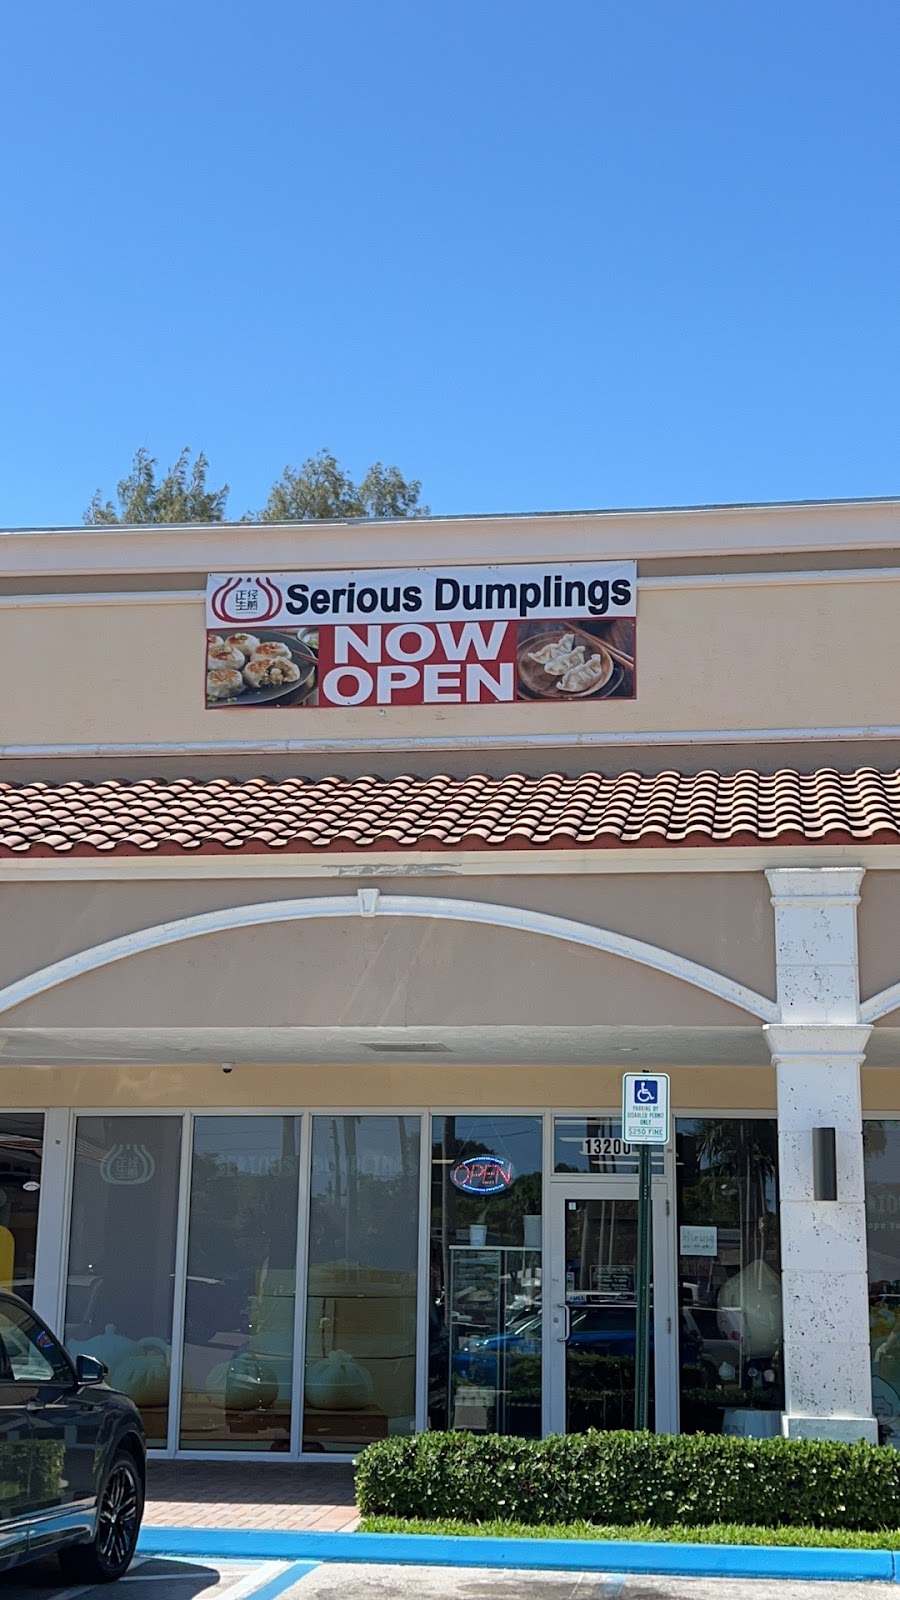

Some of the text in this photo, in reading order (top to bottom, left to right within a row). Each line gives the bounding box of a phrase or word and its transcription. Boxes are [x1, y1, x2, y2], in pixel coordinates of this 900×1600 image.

[285, 575, 631, 617] Serious Dumplings
[334, 621, 509, 664] NOW
[322, 662, 514, 706] OPEN
[585, 1138, 631, 1155] 13200
[628, 1128, 663, 1136] $250 FINE
[453, 1163, 513, 1185] OPEN
